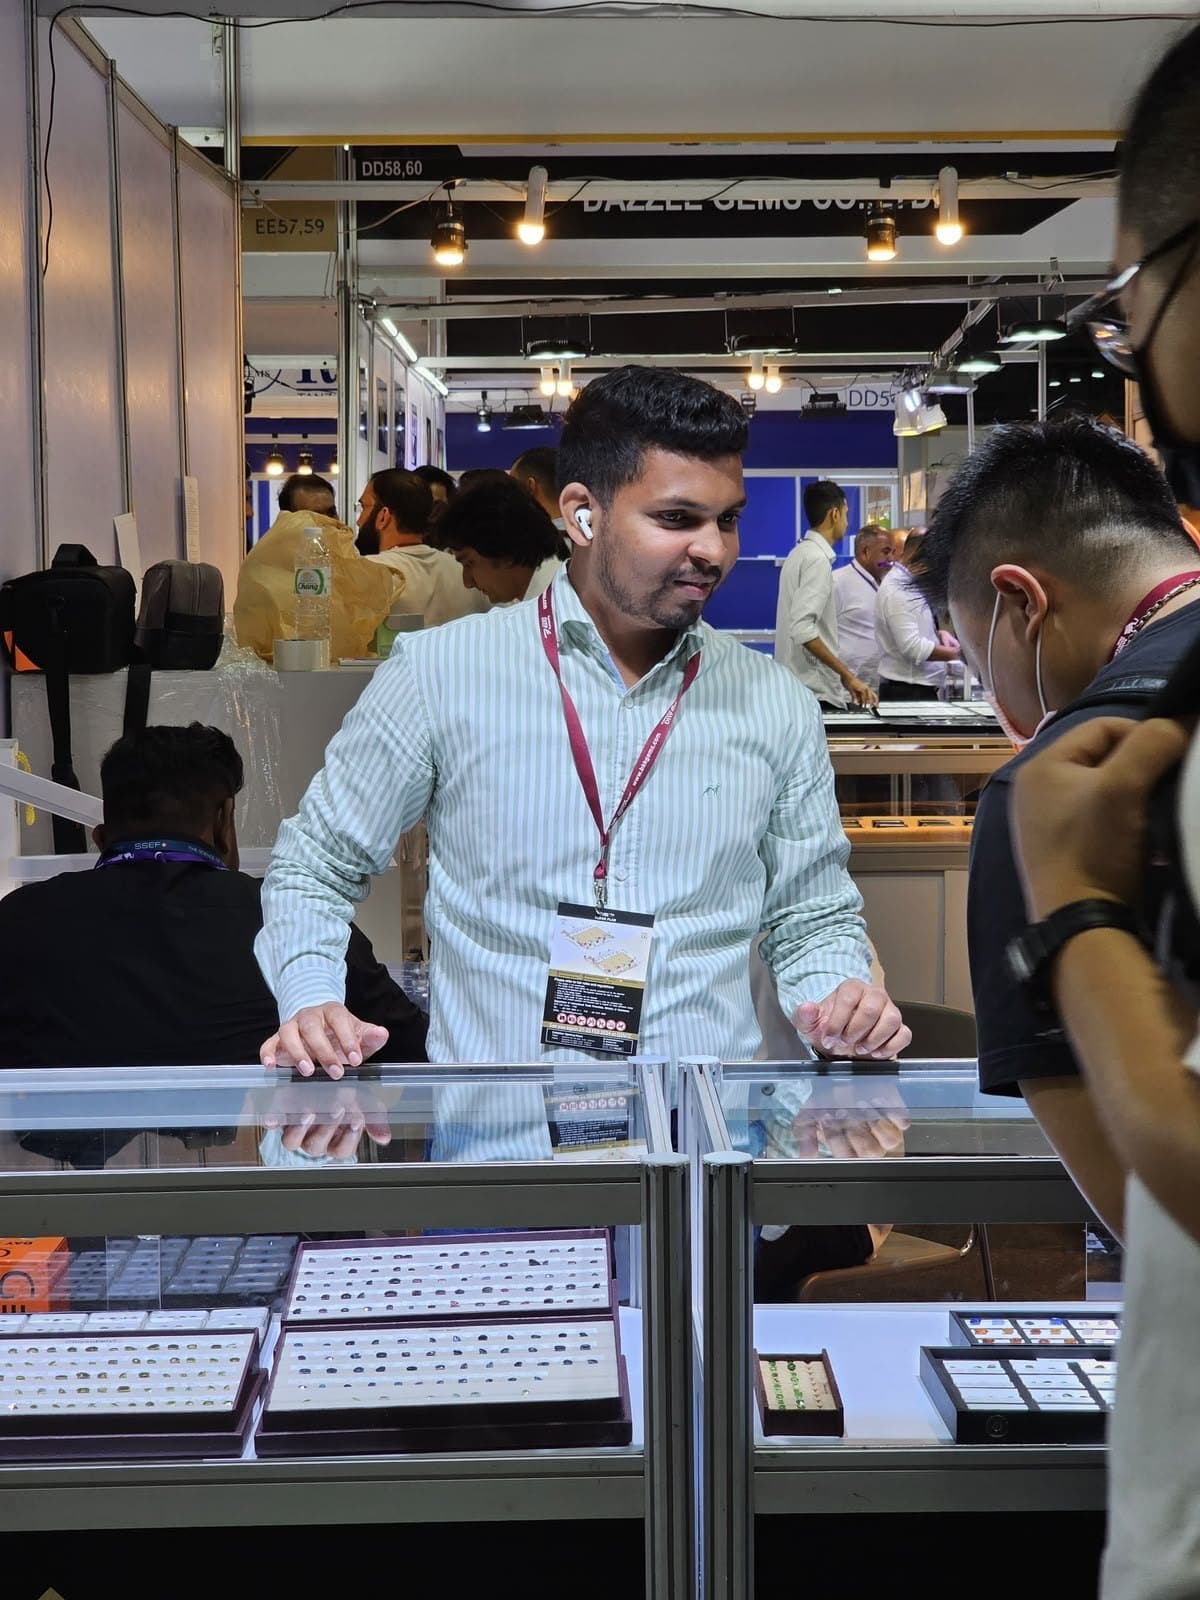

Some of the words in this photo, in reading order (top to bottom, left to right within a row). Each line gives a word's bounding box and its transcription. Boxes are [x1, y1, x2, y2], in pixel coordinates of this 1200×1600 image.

[362, 160, 423, 178] DD58,60
[255, 218, 325, 236] EE57,59
[848, 389, 896, 408] DD5
[134, 841, 161, 850] SSEF
